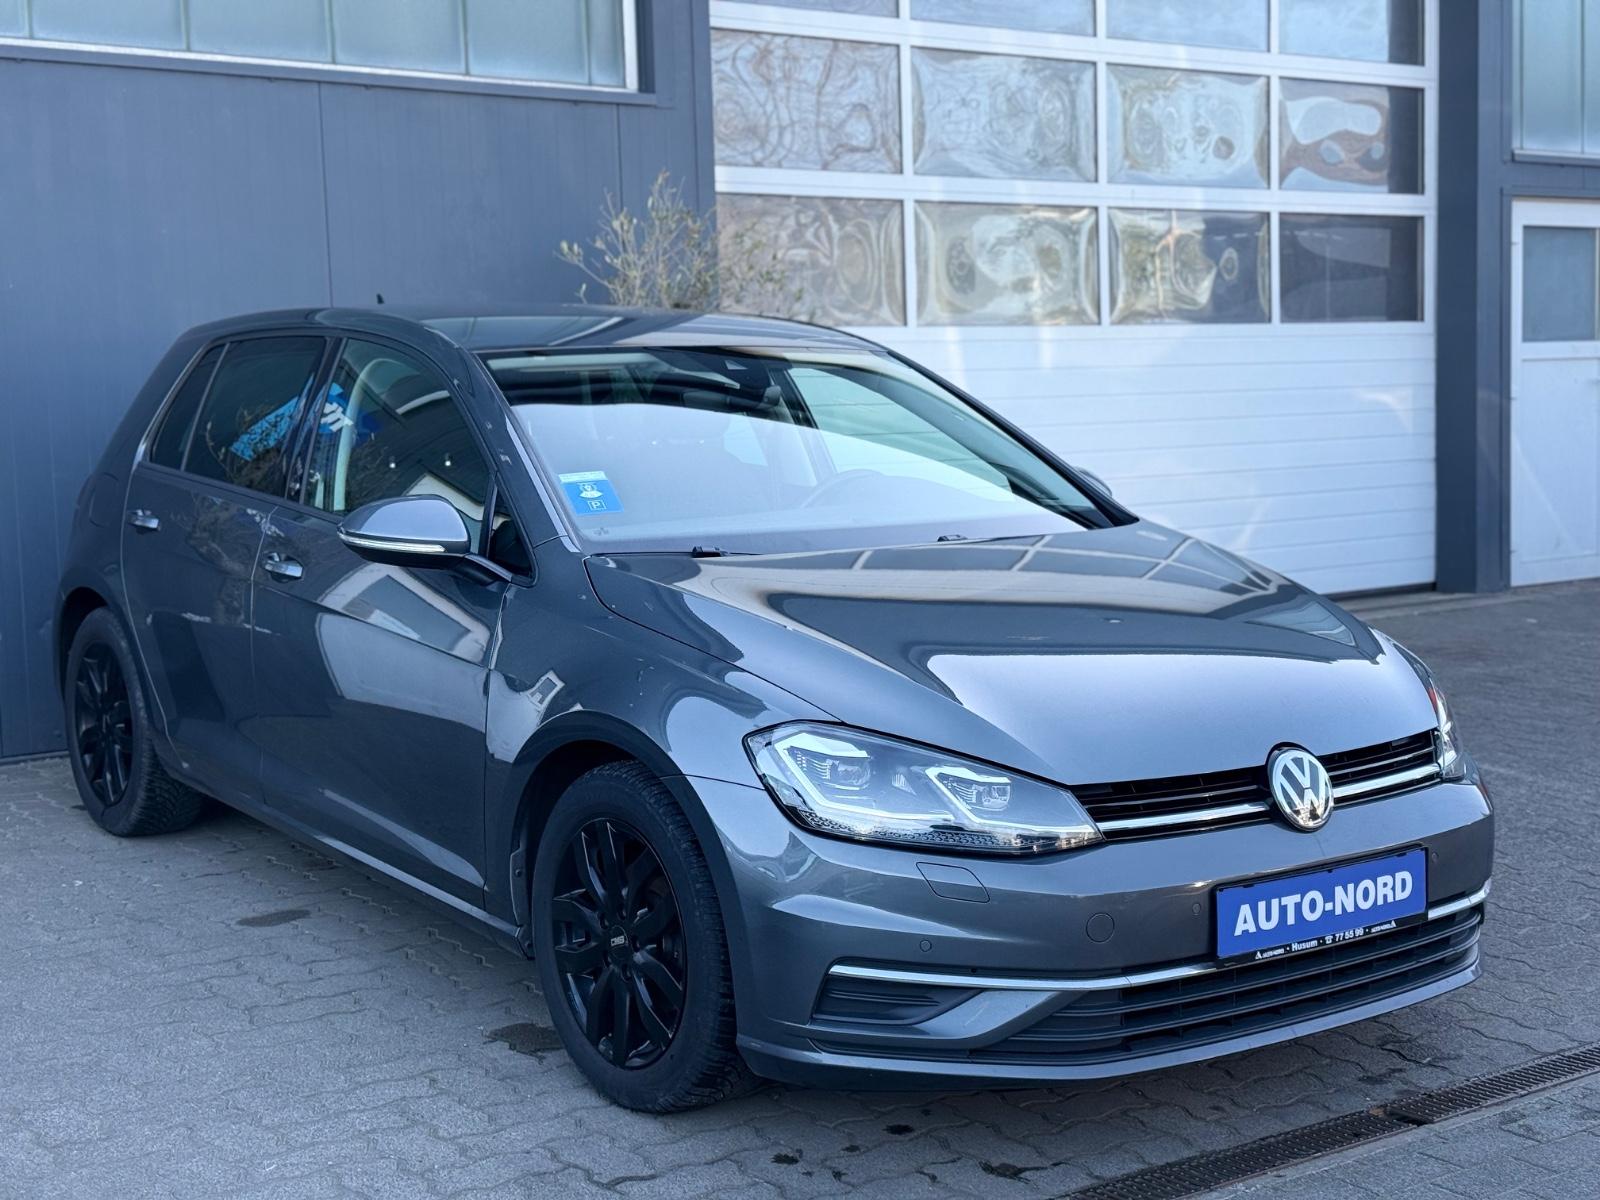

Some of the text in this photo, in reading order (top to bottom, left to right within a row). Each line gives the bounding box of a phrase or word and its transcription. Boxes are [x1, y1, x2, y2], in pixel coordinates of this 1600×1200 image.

[592, 500, 601, 509] P
[1233, 870, 1413, 936] AUTO-NORD
[1291, 939, 1318, 952] Husum
